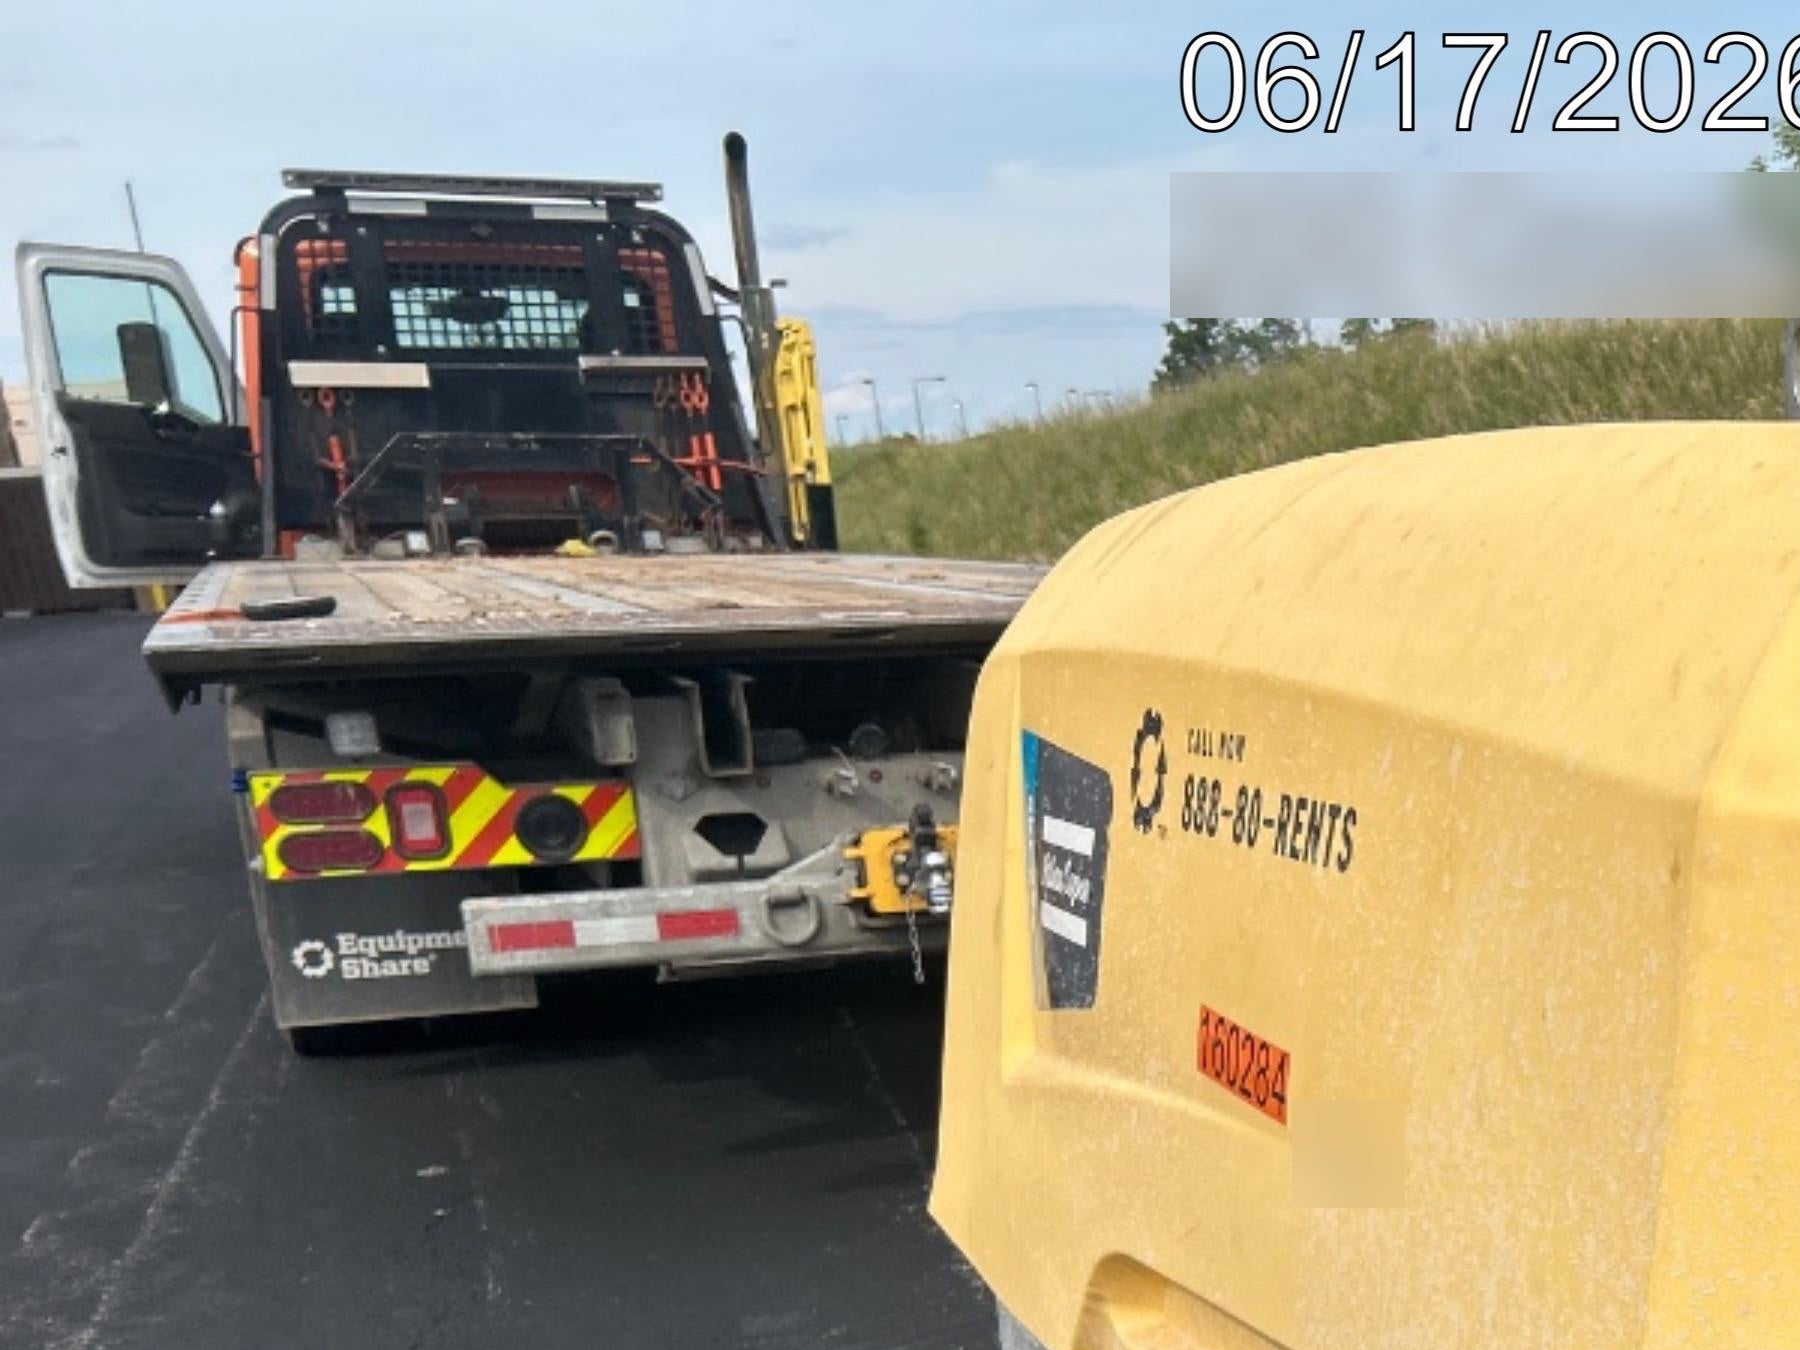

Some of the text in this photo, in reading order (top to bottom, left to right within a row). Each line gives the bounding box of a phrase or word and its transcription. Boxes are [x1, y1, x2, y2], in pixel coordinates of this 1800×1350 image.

[1181, 773, 1357, 873] 888-80-RENTS
[340, 955, 432, 979] Share
[1201, 1009, 1286, 1119] 160284
